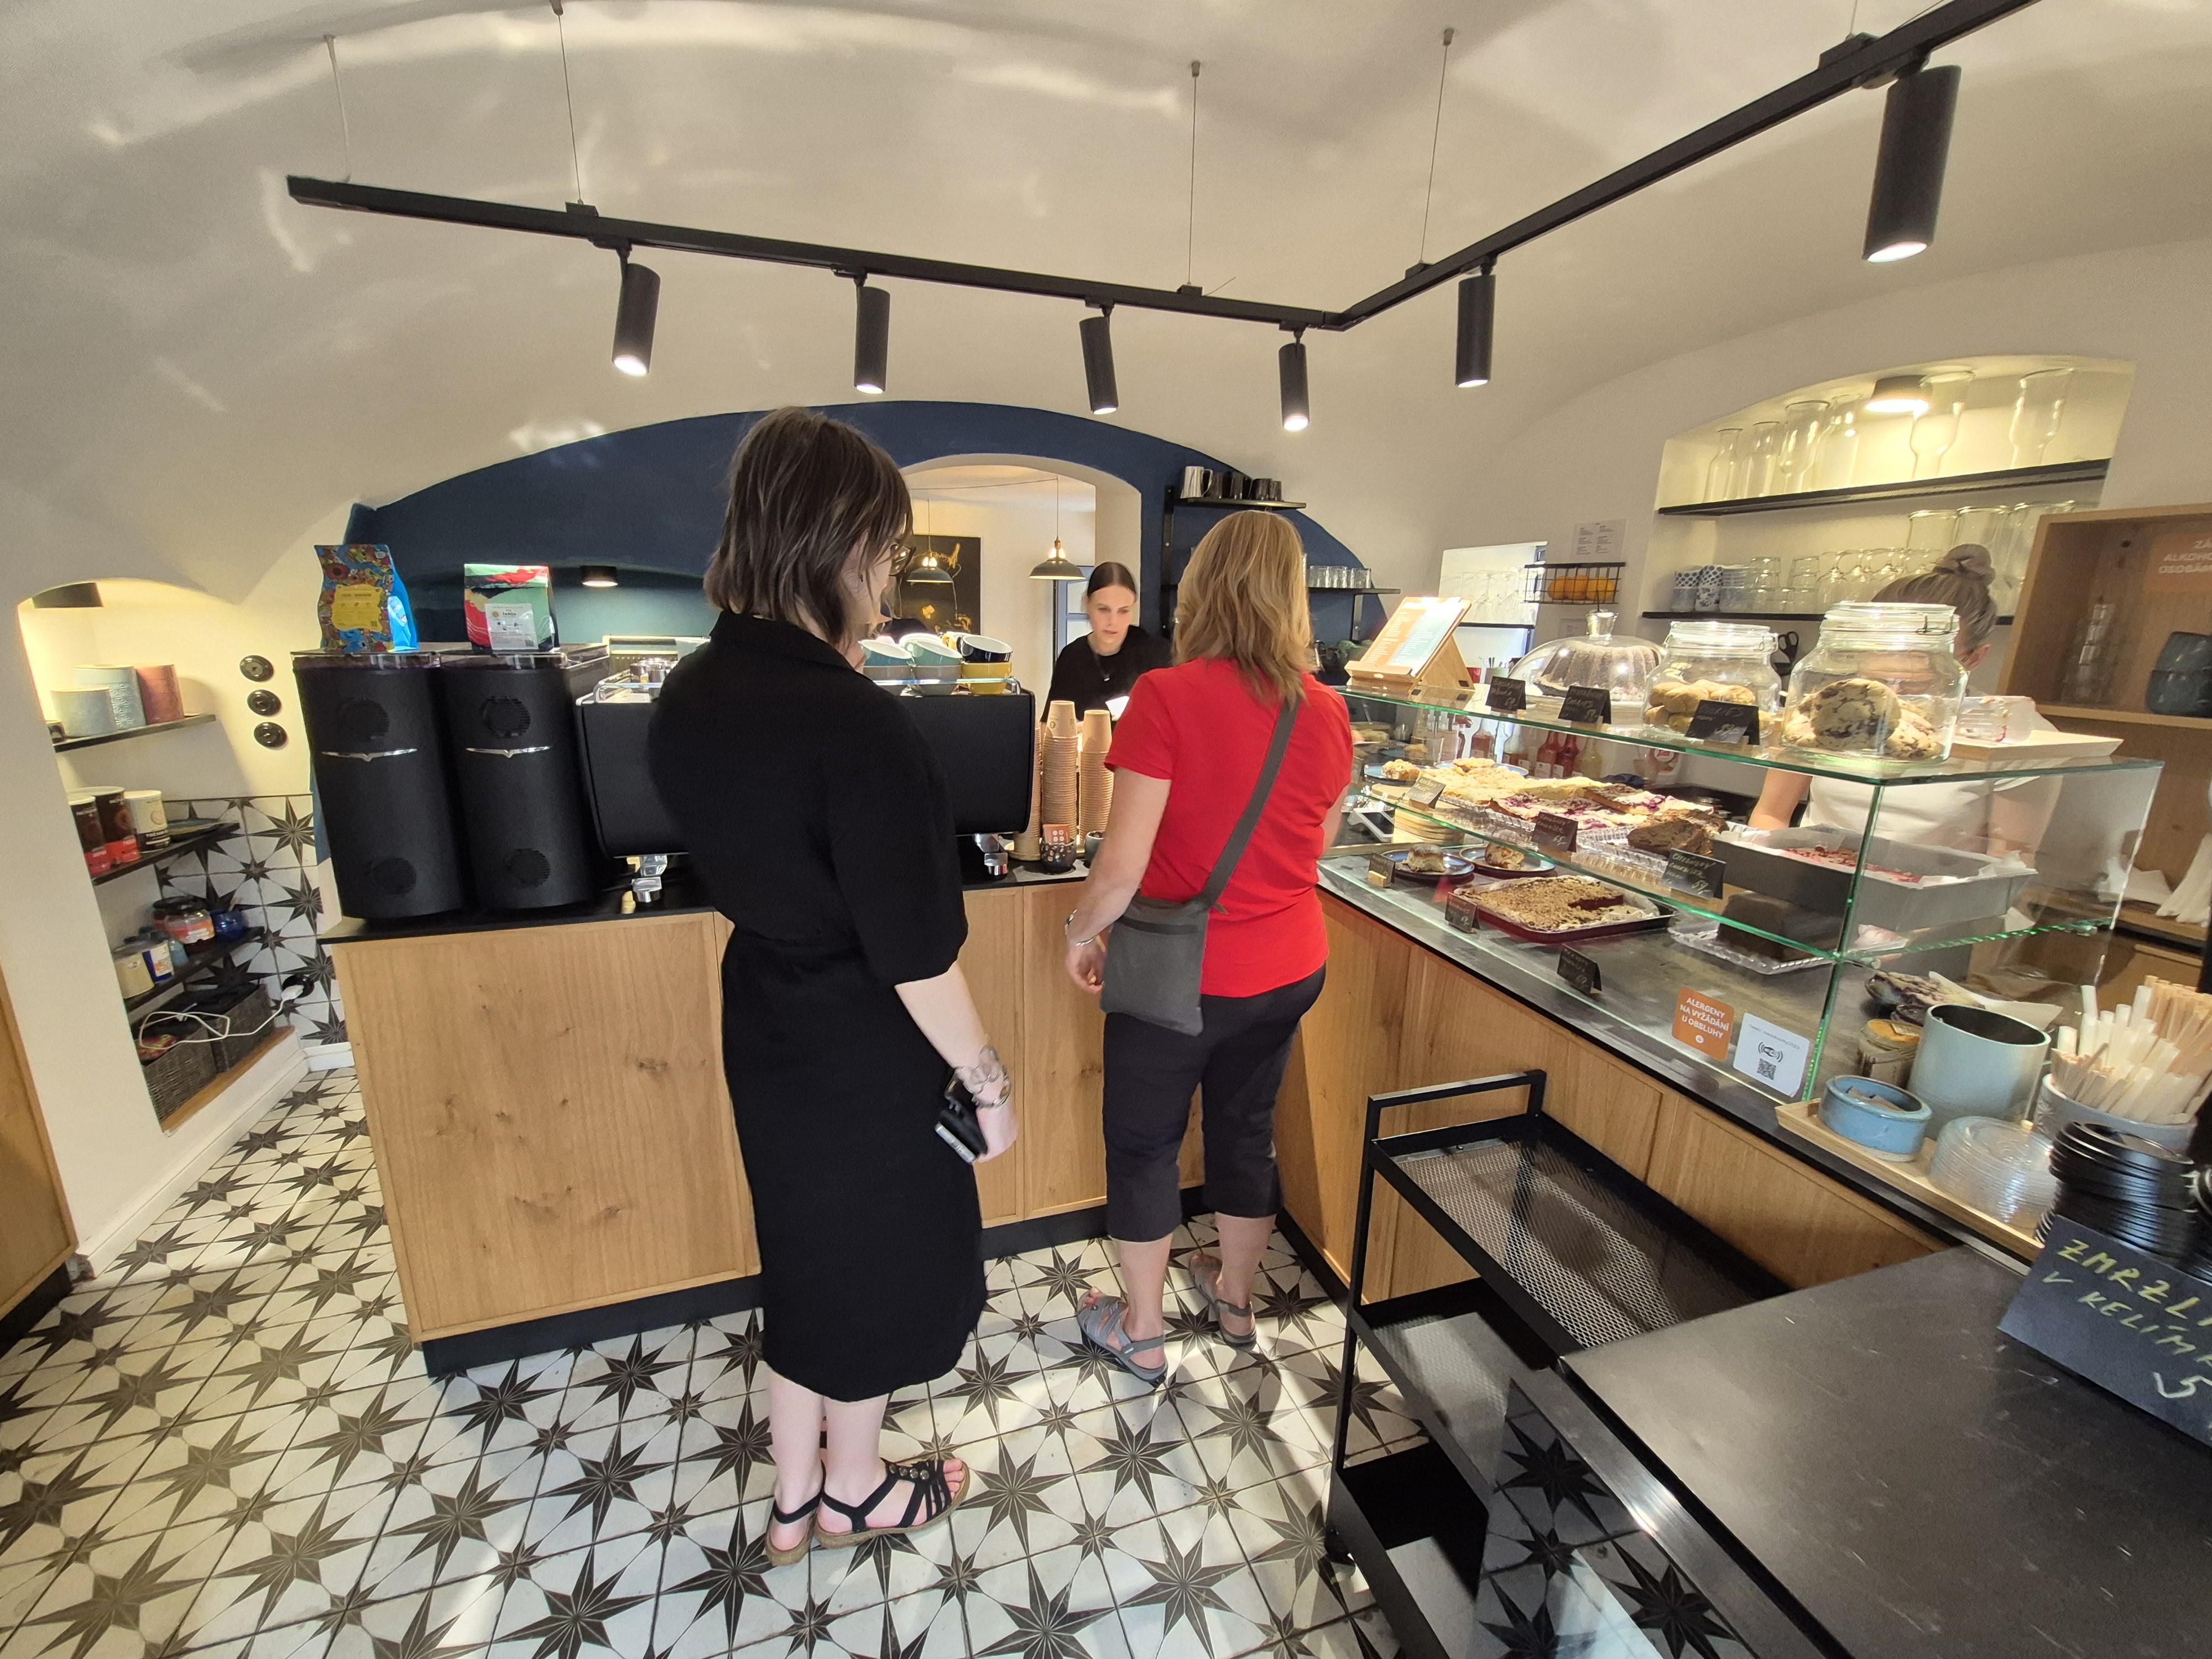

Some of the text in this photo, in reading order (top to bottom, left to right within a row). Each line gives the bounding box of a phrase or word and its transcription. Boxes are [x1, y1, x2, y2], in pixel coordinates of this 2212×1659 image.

[1680, 1004, 1691, 1014] NA
[1692, 1009, 1730, 1031] VYŽÁDÁNÍ
[1686, 997, 1725, 1019] ALERGENY
[1688, 1018, 1724, 1039] OBSLUHY
